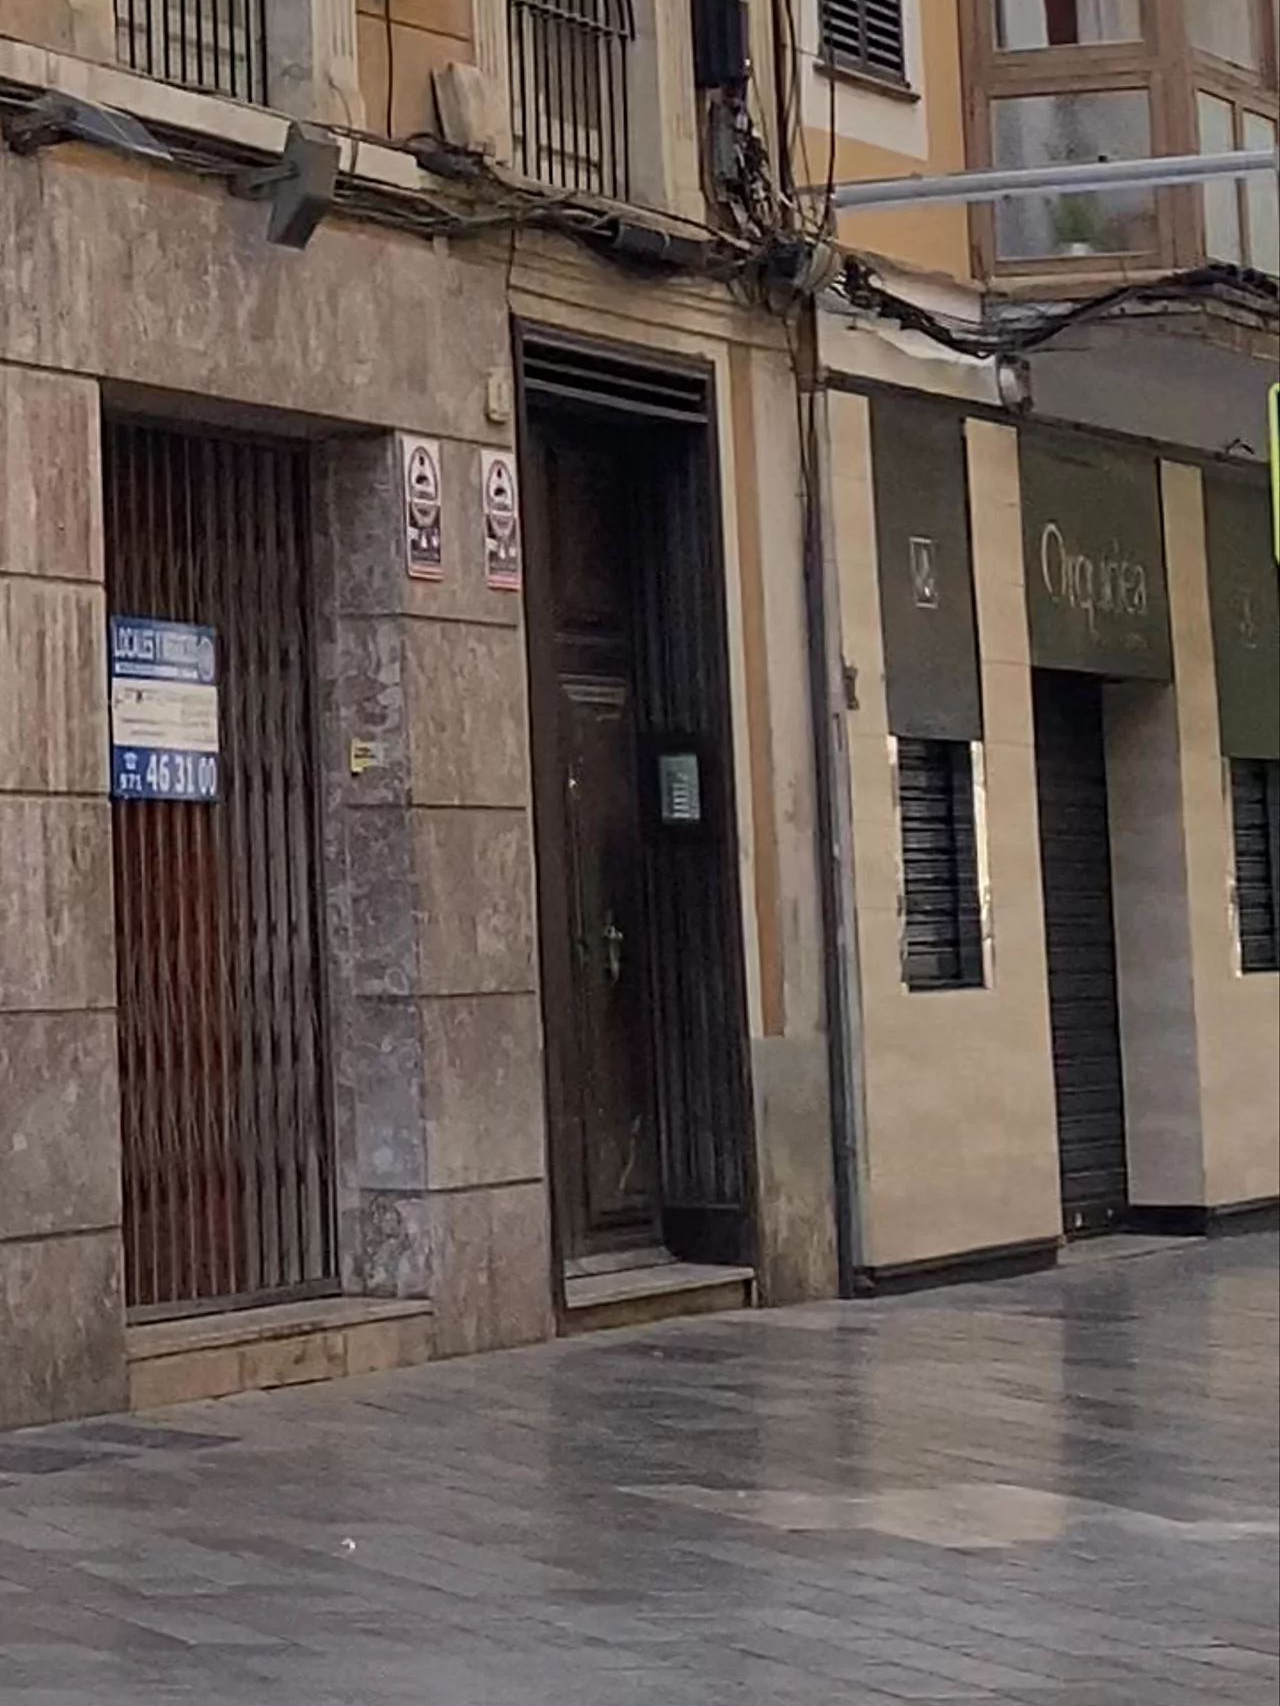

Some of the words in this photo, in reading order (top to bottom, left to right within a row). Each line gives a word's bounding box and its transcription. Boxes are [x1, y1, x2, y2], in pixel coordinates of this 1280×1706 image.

[146, 753, 171, 792] 46
[174, 754, 195, 794] 31
[198, 757, 217, 796] 00
